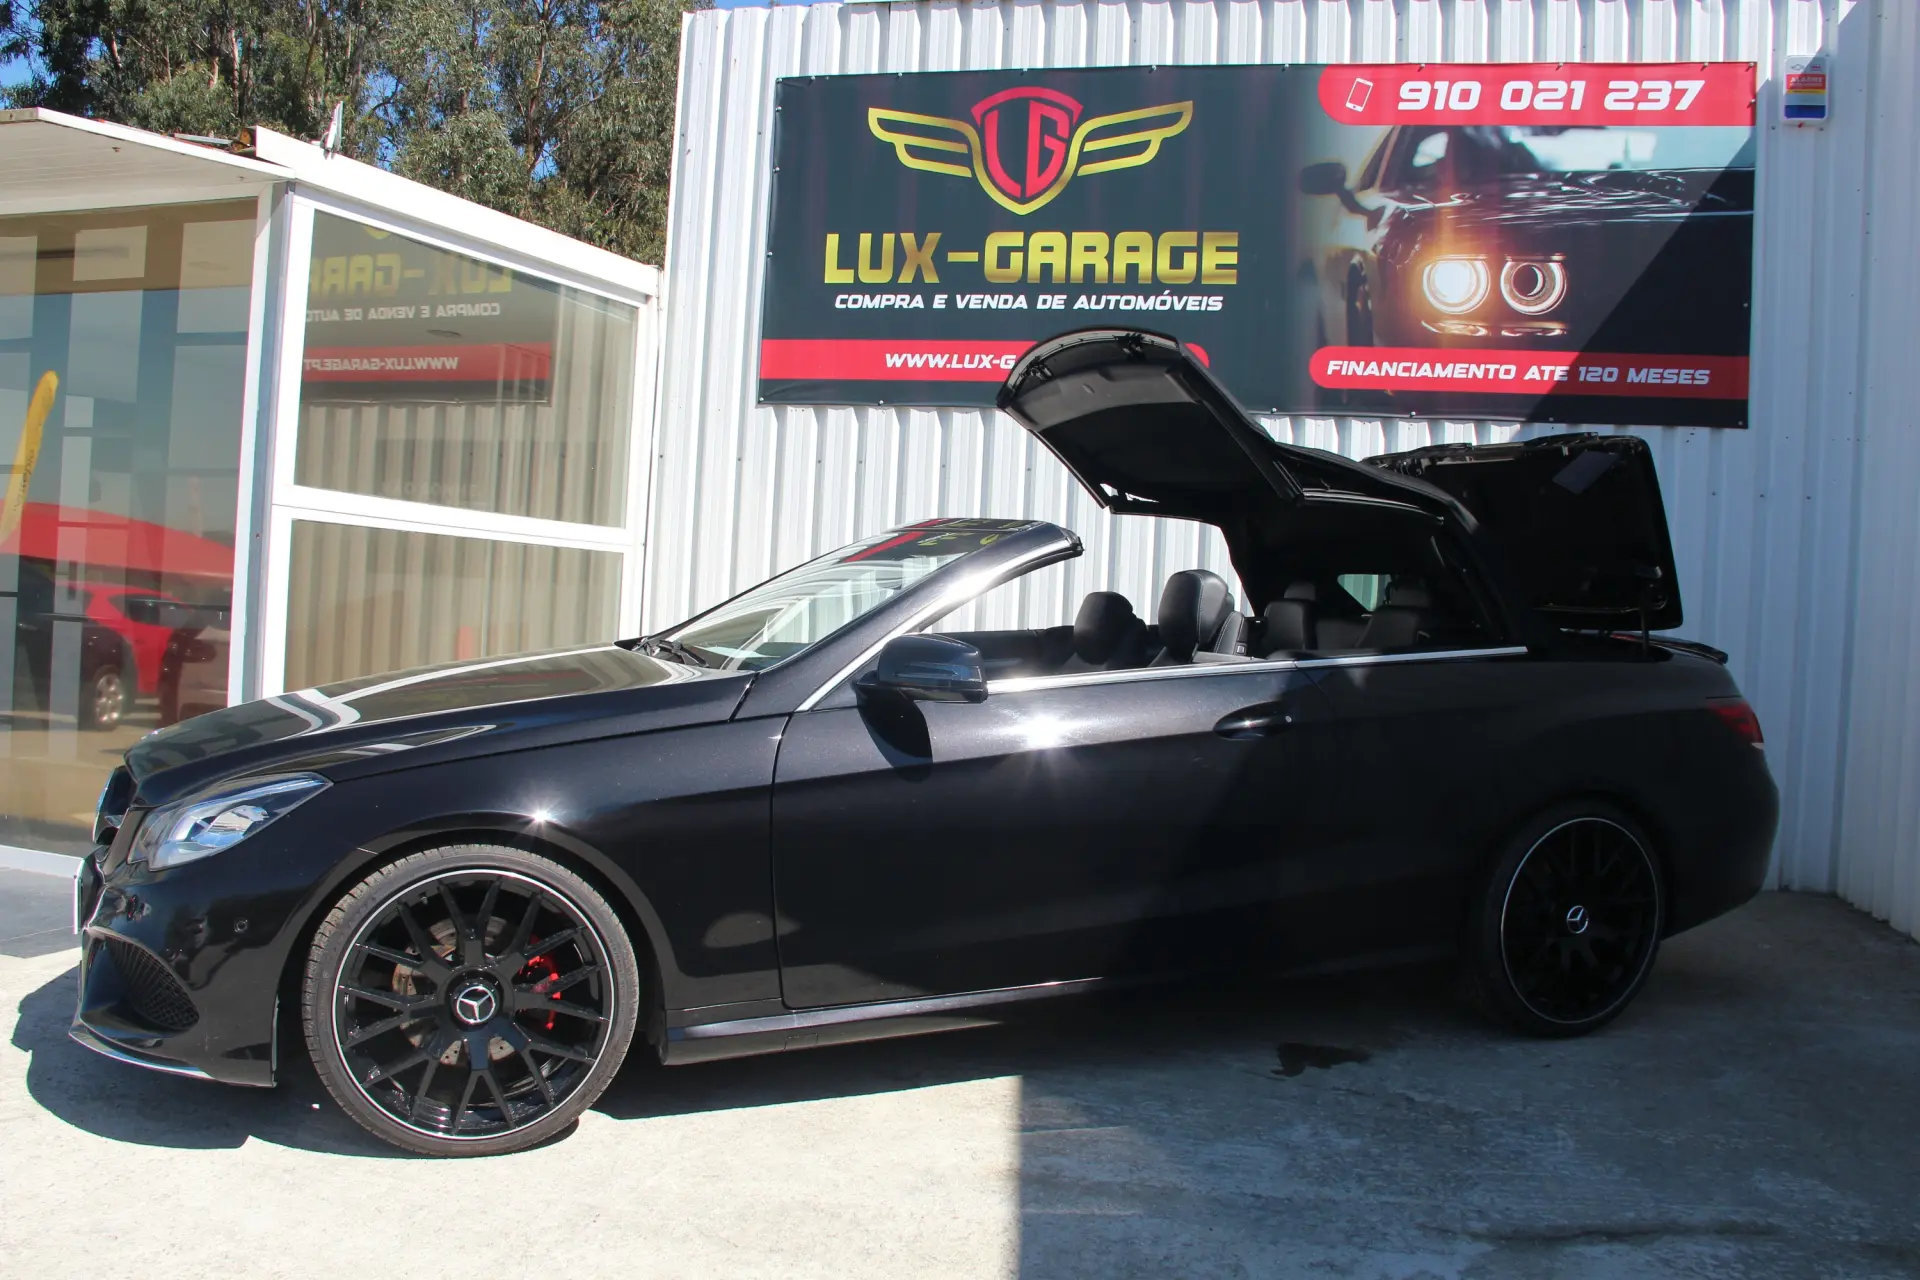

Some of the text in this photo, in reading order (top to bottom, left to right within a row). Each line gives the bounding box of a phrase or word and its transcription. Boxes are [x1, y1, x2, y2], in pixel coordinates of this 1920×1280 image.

[1397, 79, 1706, 111] 910 021 237
[823, 230, 1239, 286] LUX-GARAGE
[834, 289, 1224, 312] COMPRA E VENDA DE AUTOMÓVEIS
[885, 352, 1018, 370] WWW.LUX-G
[1326, 359, 1711, 386] FINANCIAMENTO ATE 120 MESES
